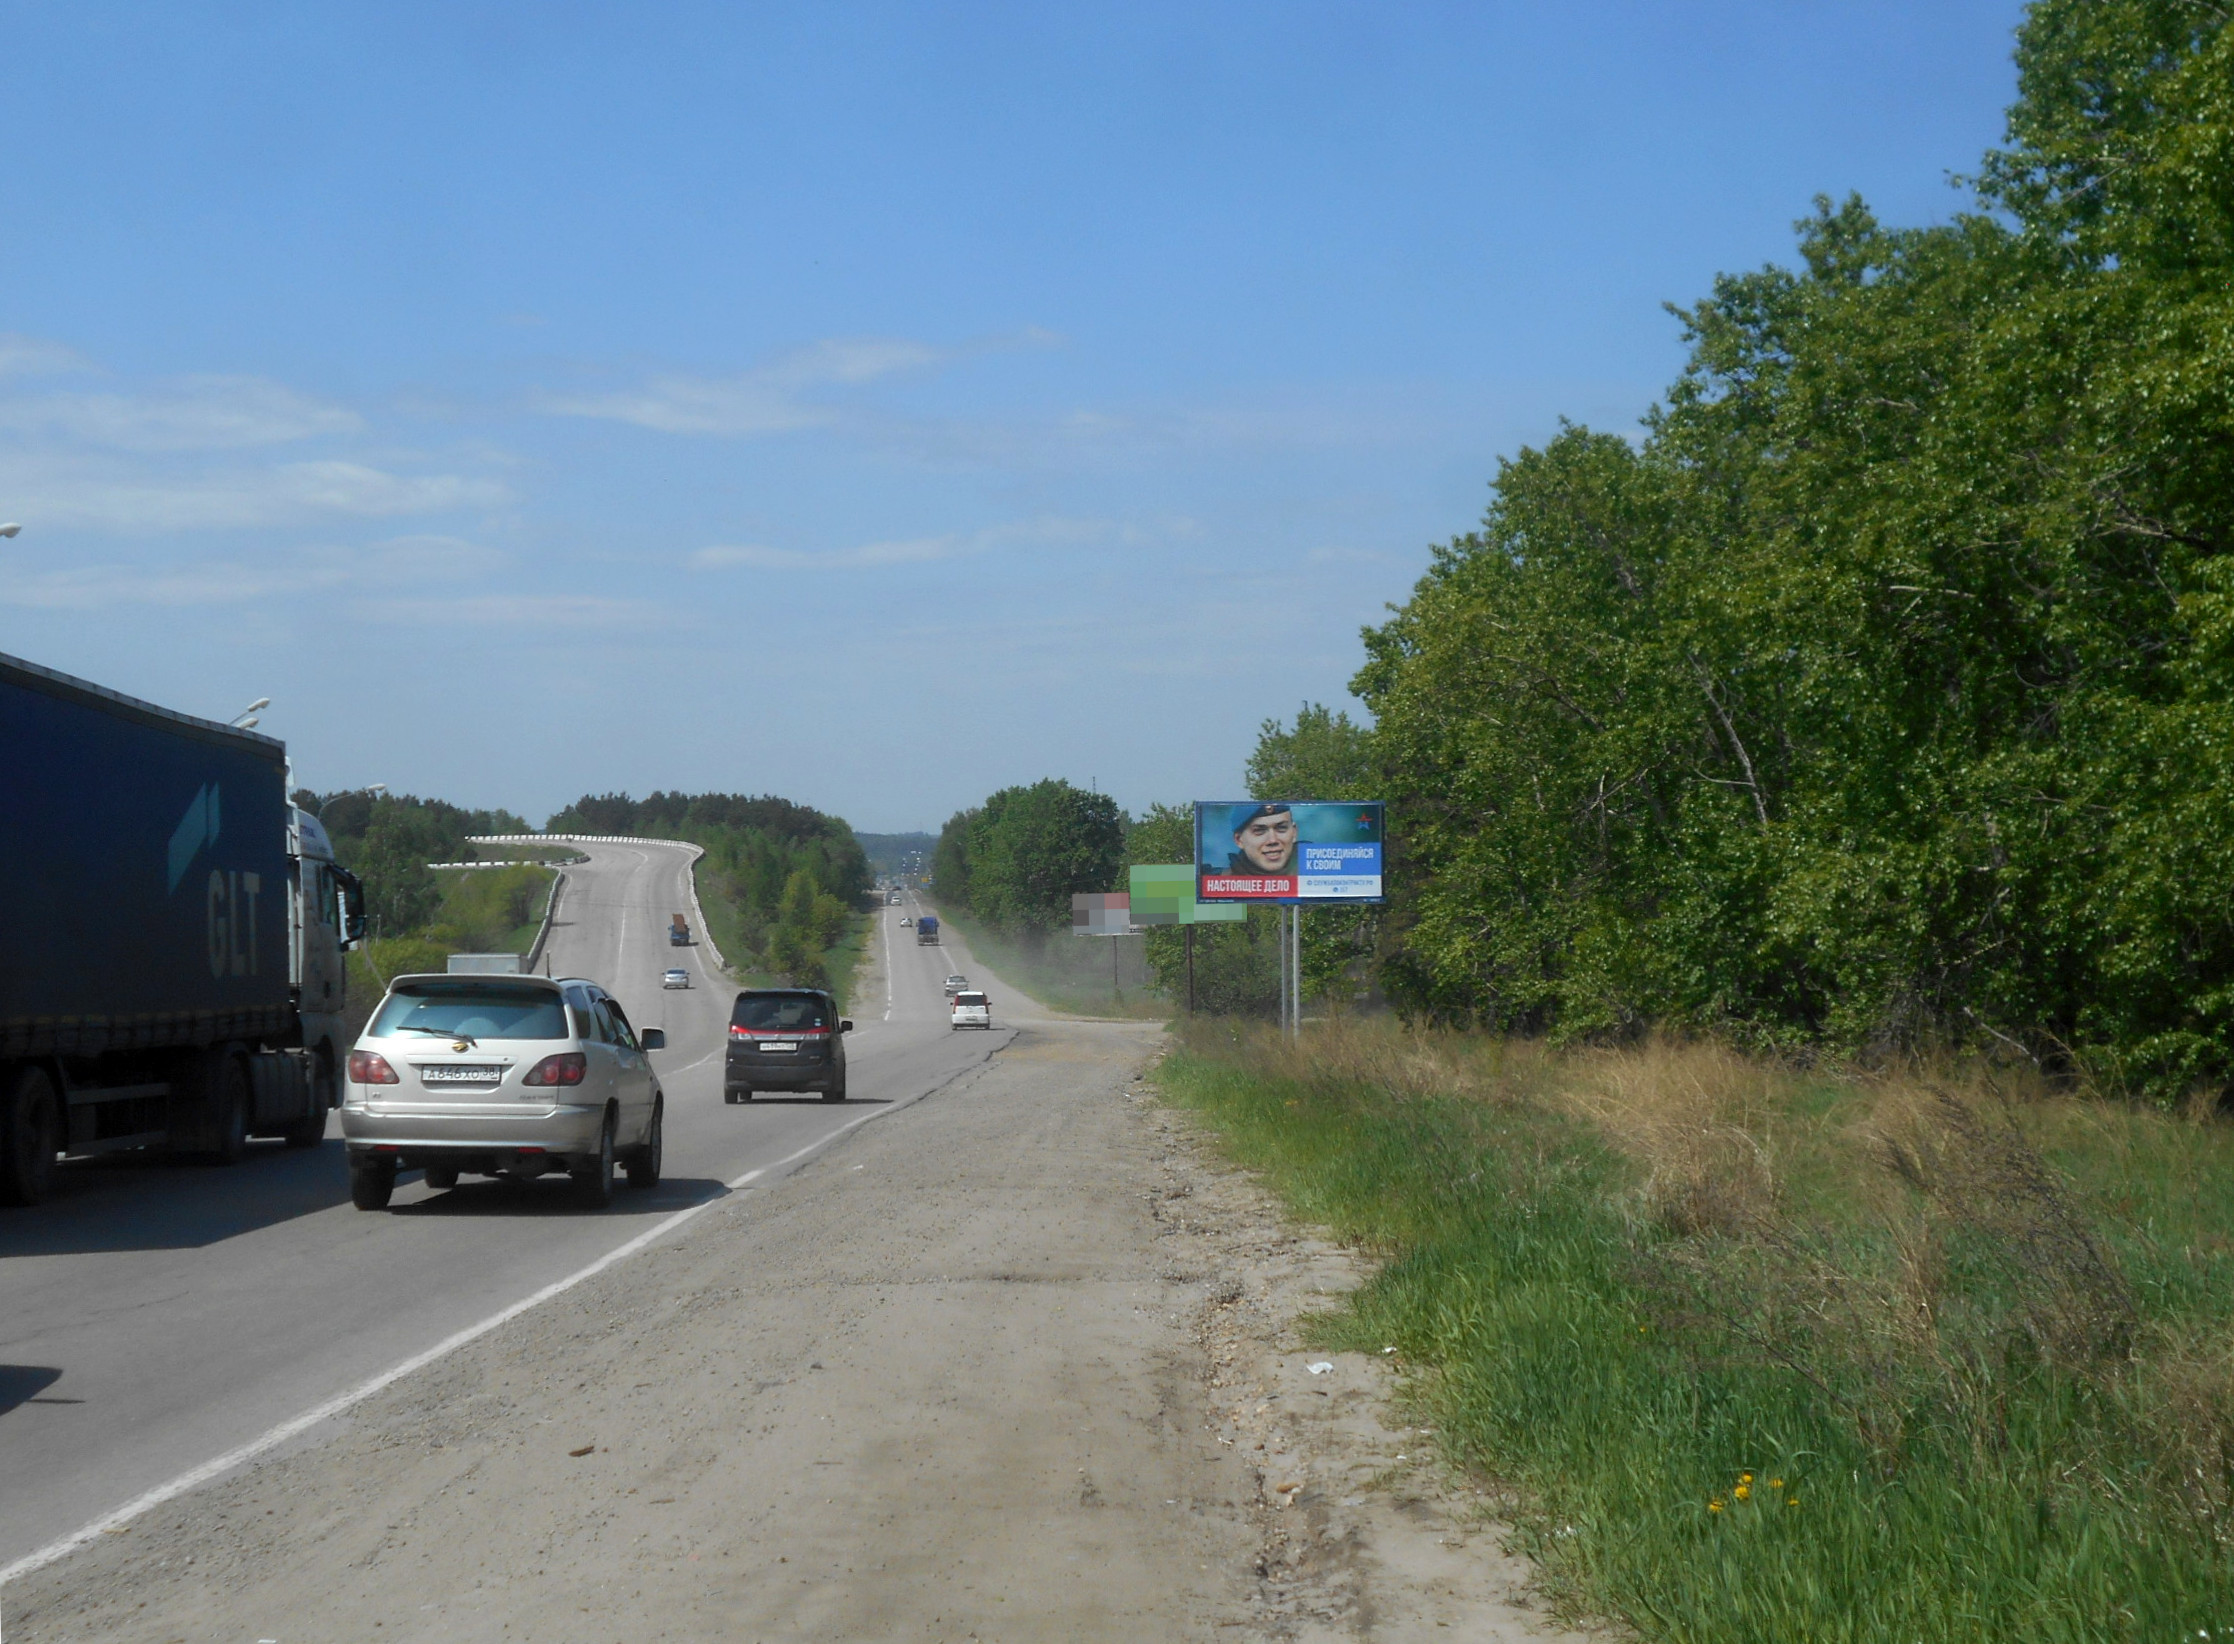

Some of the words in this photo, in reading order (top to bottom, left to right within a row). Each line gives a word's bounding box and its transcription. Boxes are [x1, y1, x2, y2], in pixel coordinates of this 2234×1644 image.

[1306, 846, 1374, 860] ПРИСОЕДИНЯЙСЯ
[1306, 860, 1312, 870] К
[1314, 860, 1341, 870] СВОИМ
[1207, 879, 1262, 892] НАСТОЯЩЕЕ
[1263, 879, 1290, 893] ДЕЛО
[208, 869, 260, 979] GLT
